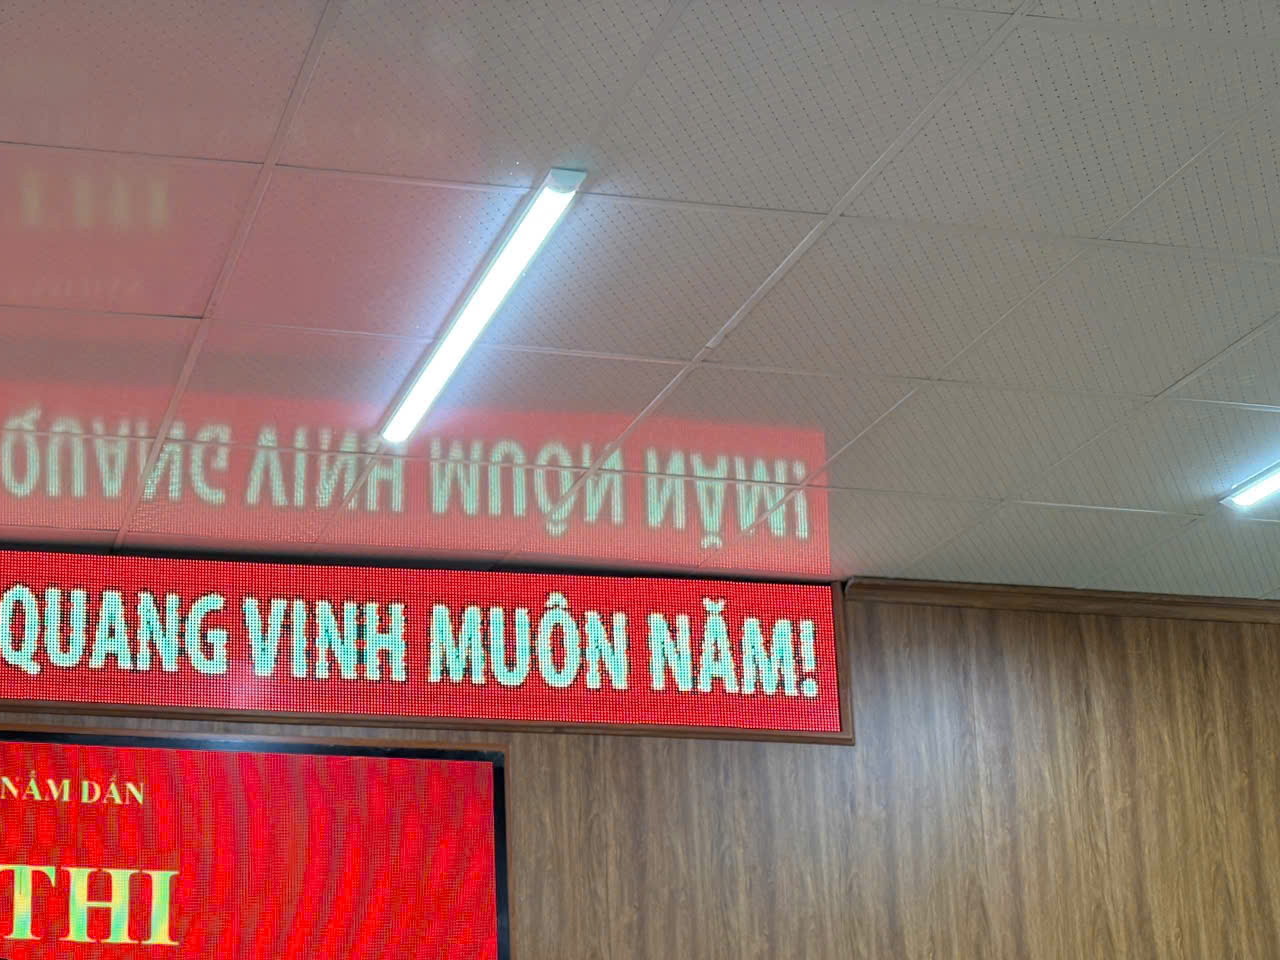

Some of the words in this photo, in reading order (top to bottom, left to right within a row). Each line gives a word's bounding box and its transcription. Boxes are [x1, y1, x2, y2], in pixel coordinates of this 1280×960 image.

[242, 597, 407, 682] VINH
[428, 592, 629, 690] MUÔN
[647, 597, 819, 698] NĂM!
